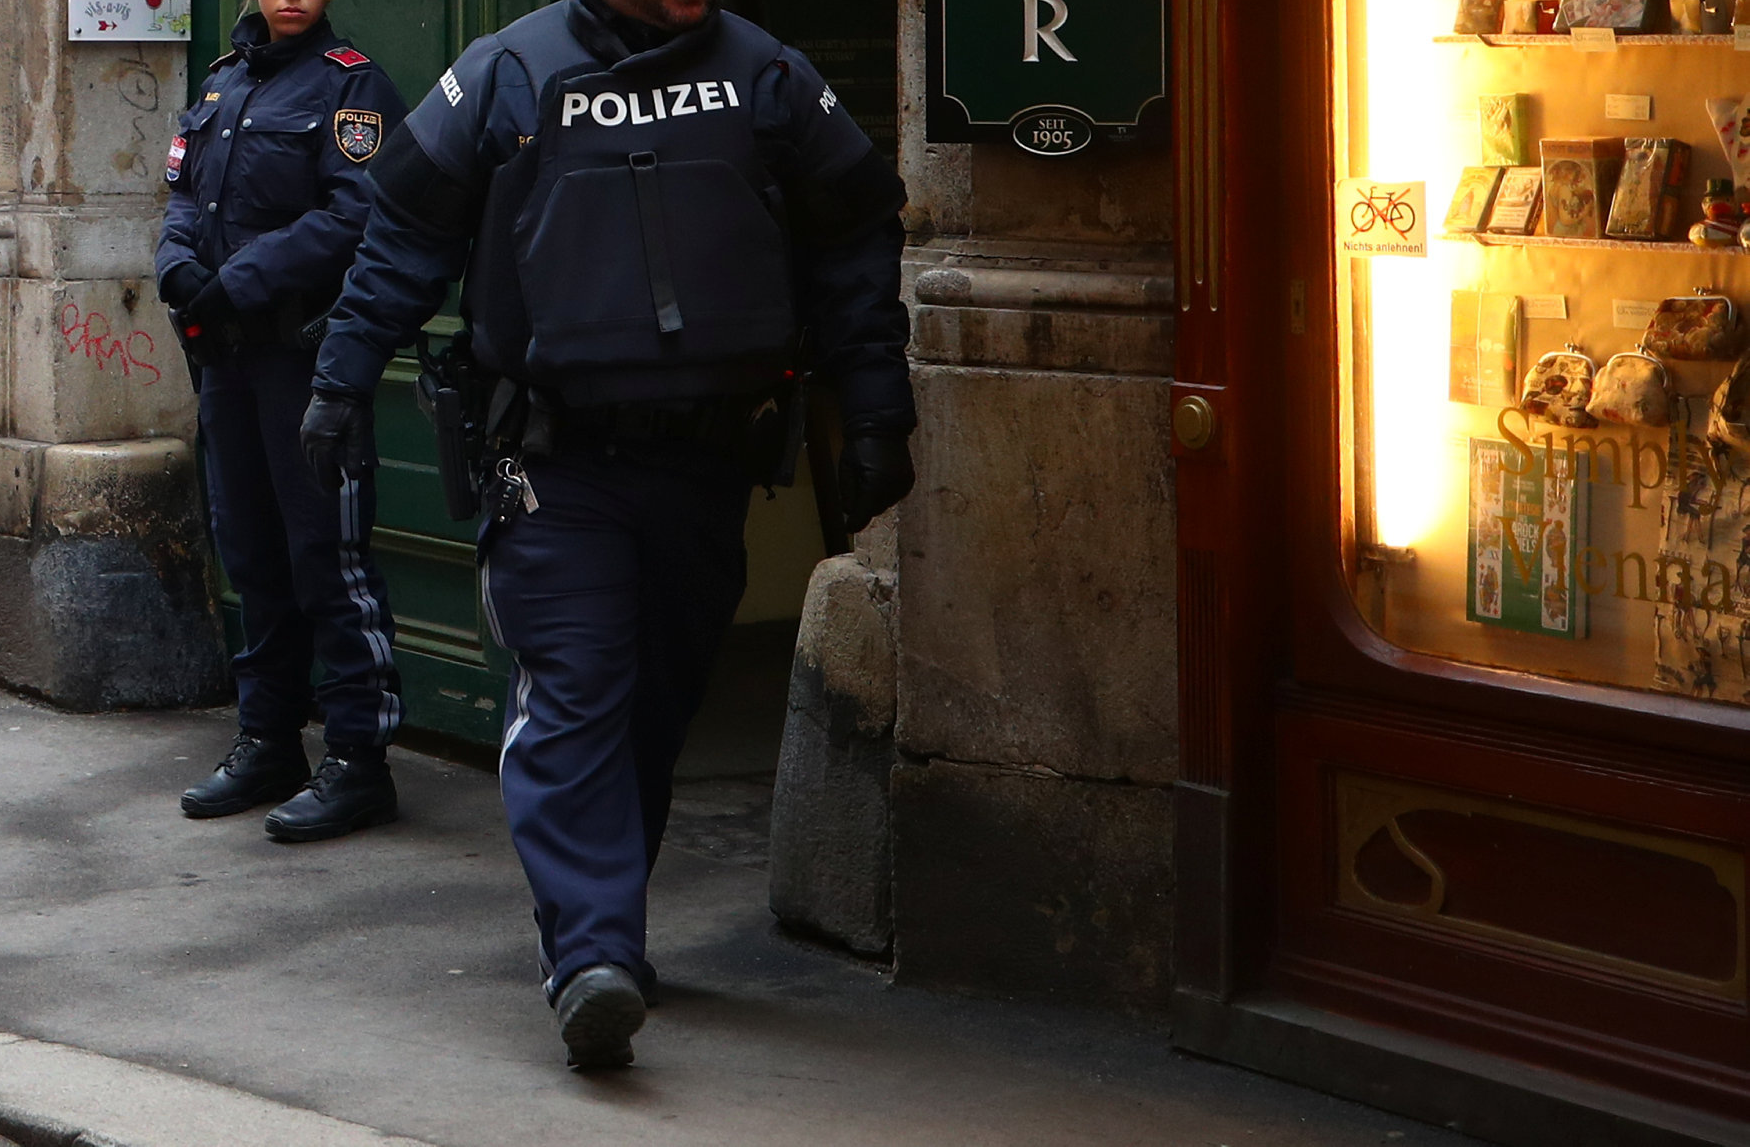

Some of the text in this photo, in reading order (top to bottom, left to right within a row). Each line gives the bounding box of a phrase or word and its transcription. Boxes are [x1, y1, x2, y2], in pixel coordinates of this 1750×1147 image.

[561, 81, 741, 127] POLIZEI
[1038, 118, 1066, 130] SEIT
[1032, 129, 1072, 151] 1905
[1343, 241, 1423, 253] Nichts anlehnen!
[1497, 406, 1732, 517] Simply
[1512, 522, 1540, 539] AROCK
[1495, 516, 1733, 614] Vienna
